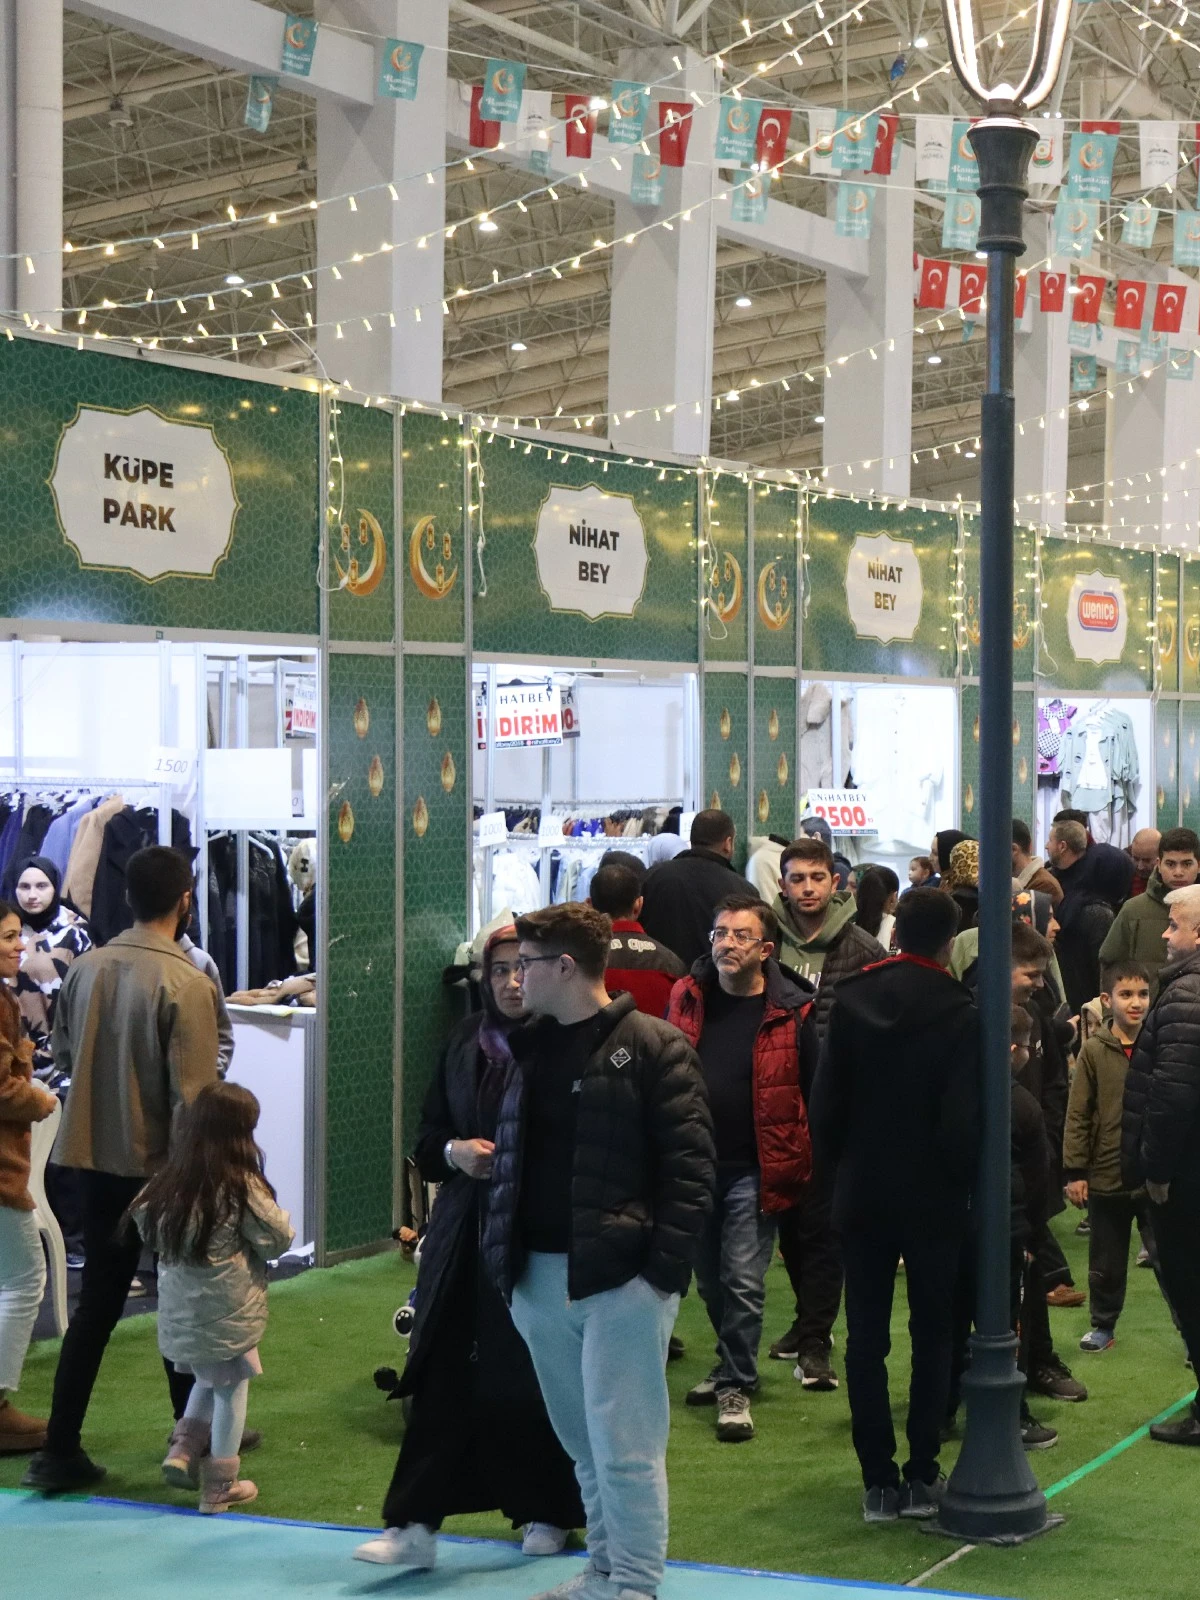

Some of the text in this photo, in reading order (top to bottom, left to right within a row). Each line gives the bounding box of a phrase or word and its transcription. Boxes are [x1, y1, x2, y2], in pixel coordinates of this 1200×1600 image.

[104, 452, 174, 489] KÜPE
[103, 497, 177, 533] PARK
[569, 518, 620, 551] NİHAT
[578, 560, 610, 584] BEY
[868, 556, 903, 584] NİHAT
[874, 591, 897, 611] BEY
[477, 707, 559, 739] İDİRİM
[154, 758, 189, 773] 1500
